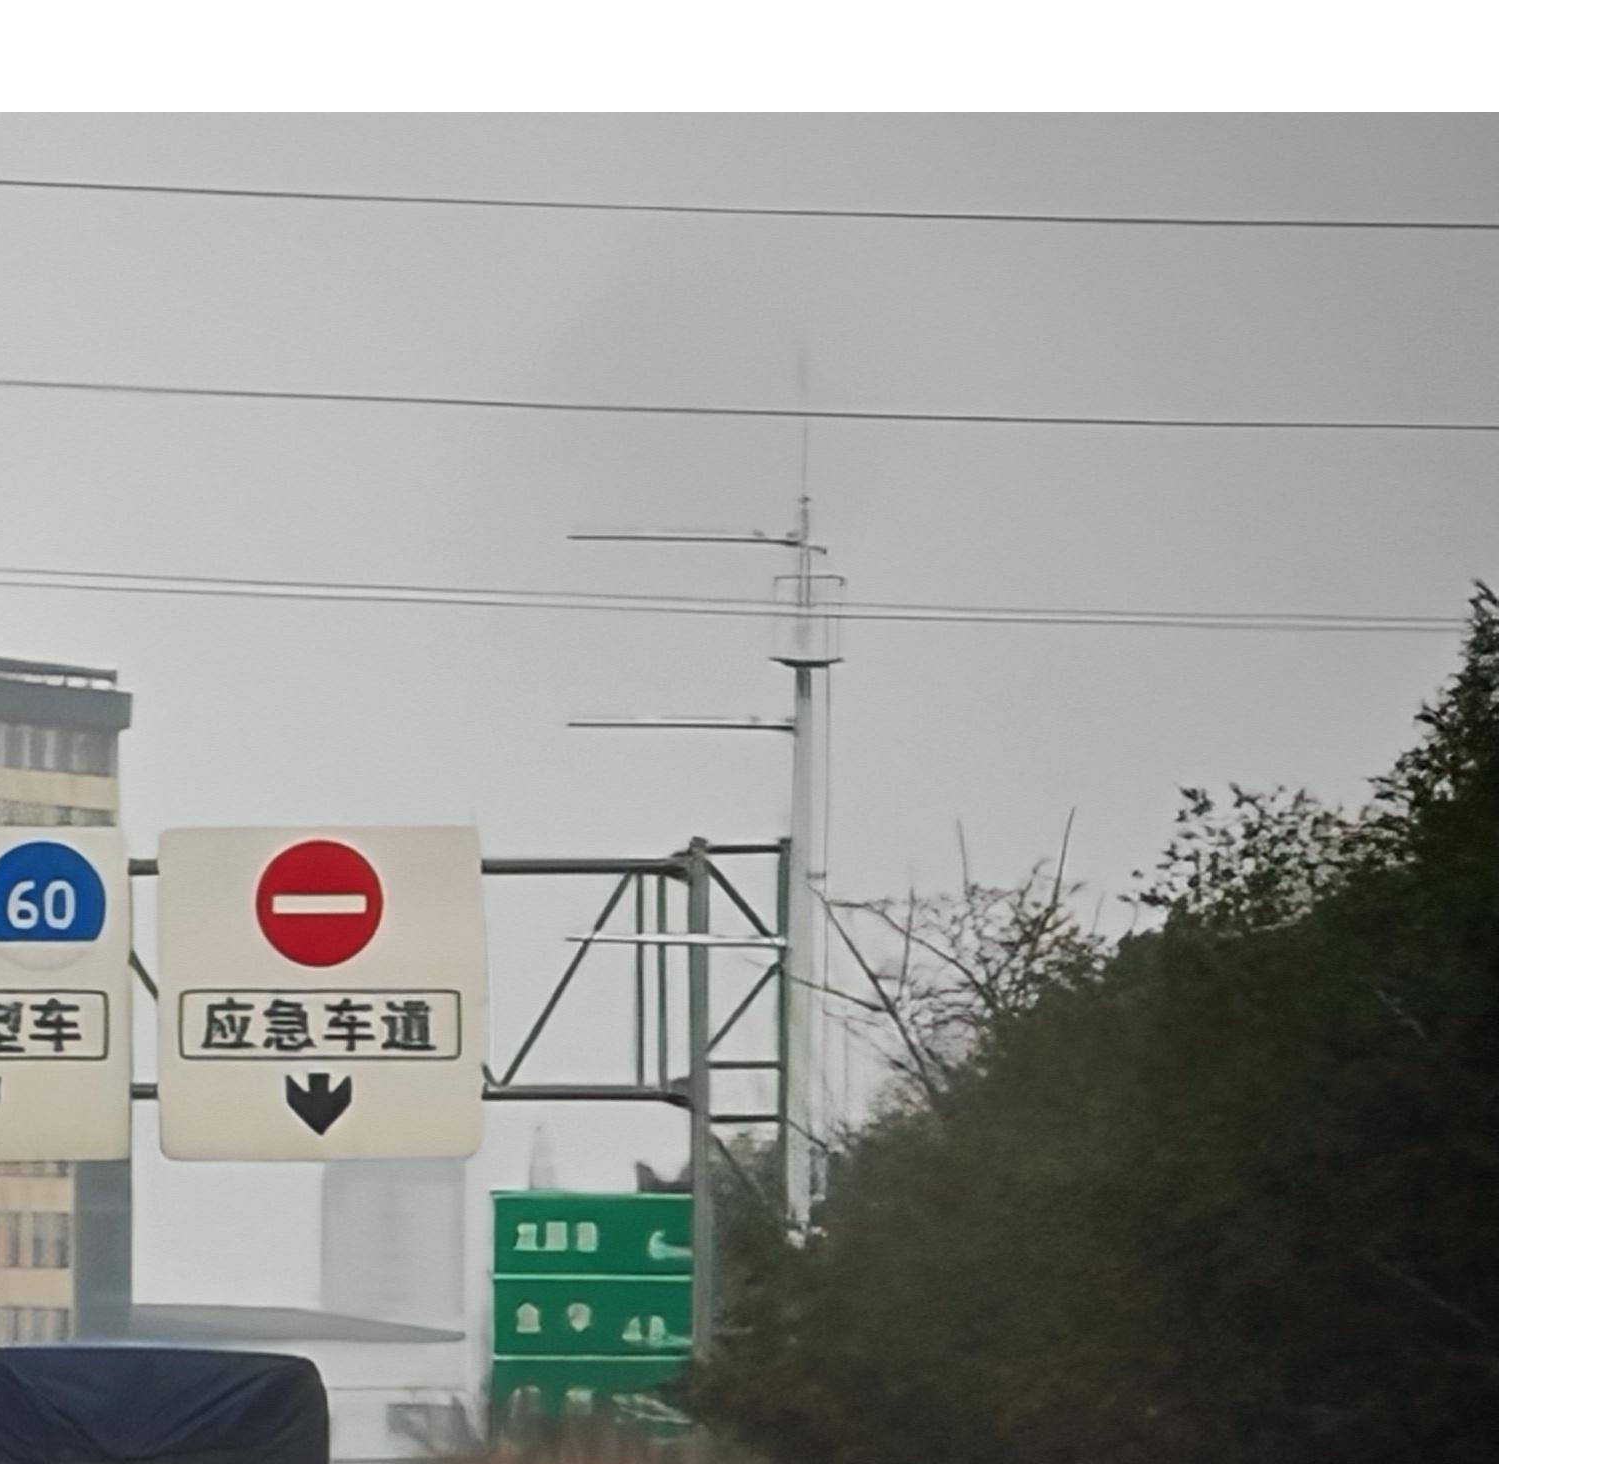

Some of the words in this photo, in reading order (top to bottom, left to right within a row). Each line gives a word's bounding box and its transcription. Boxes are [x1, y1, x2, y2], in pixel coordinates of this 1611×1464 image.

[8, 880, 75, 929] 60
[201, 997, 437, 1053] 应急车道
